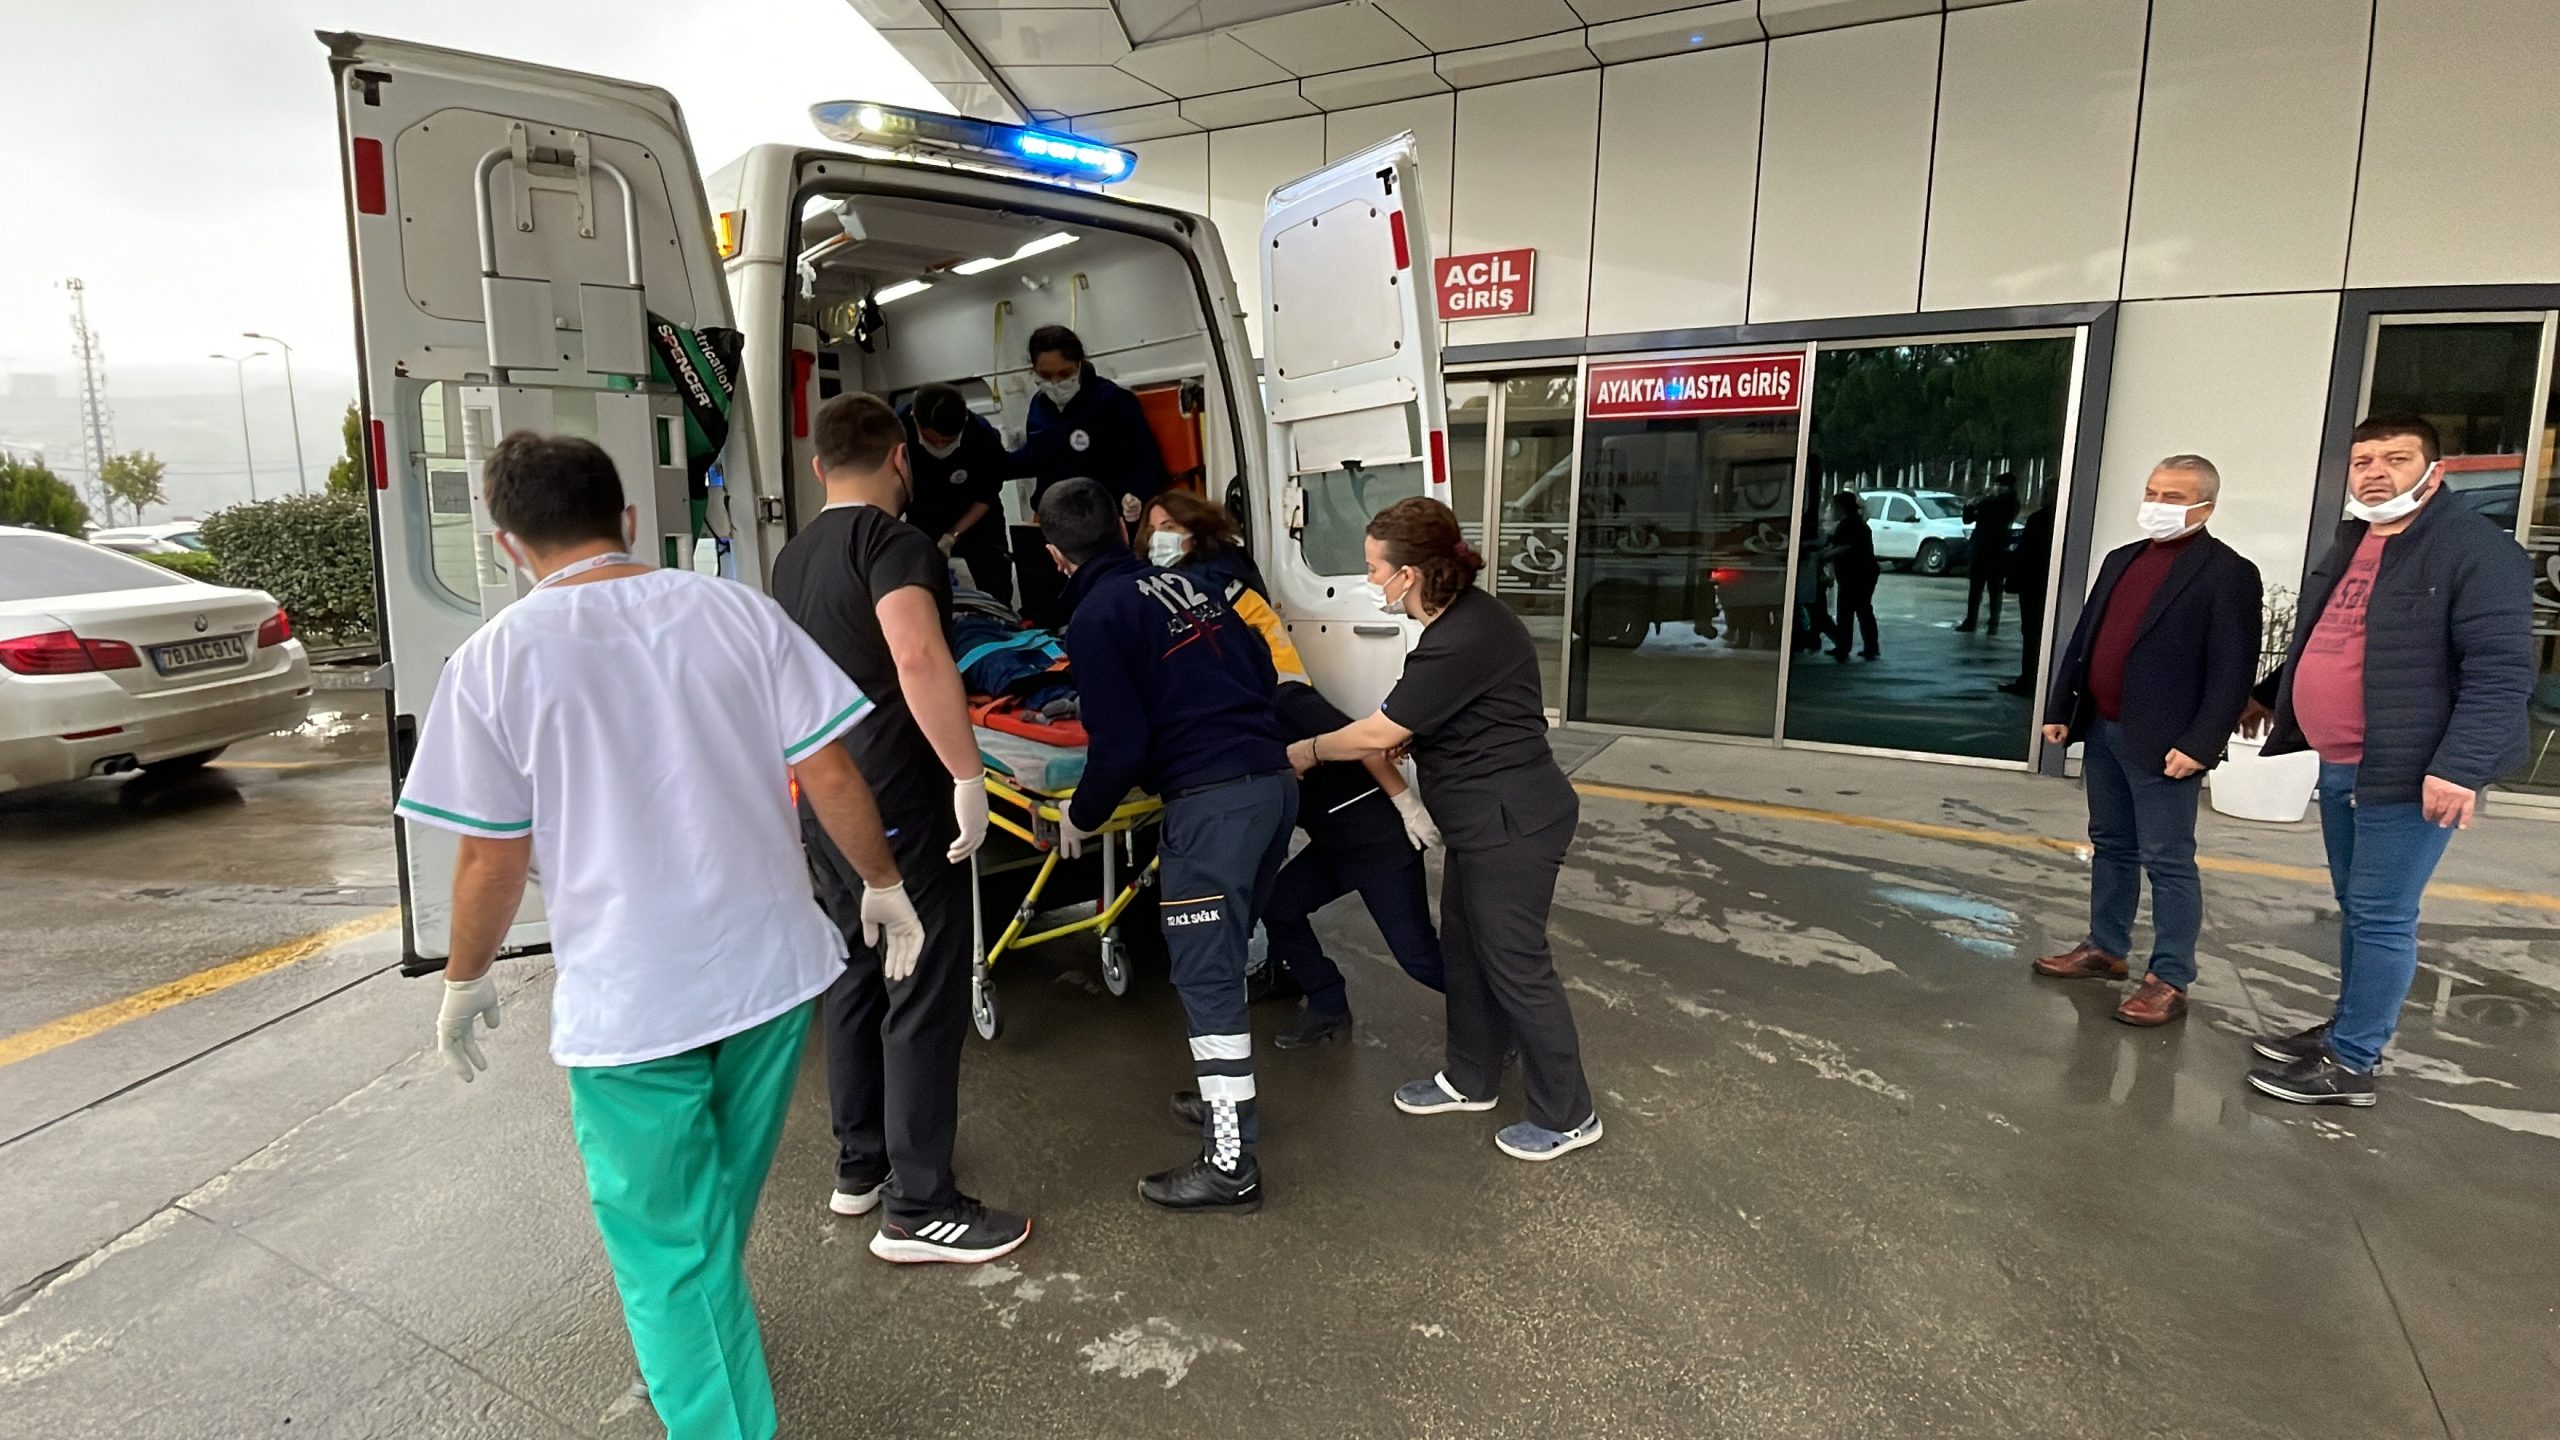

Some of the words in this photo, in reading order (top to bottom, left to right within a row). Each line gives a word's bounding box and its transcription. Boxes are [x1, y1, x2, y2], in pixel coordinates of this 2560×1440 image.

[1444, 256, 1520, 287] ACİL
[1449, 285, 1514, 310] GİRİŞ
[658, 324, 711, 407] SPENCER
[1597, 378, 1665, 404] AYAKTA
[1738, 366, 1791, 400] GİRİŞ
[1136, 573, 1208, 614] 112
